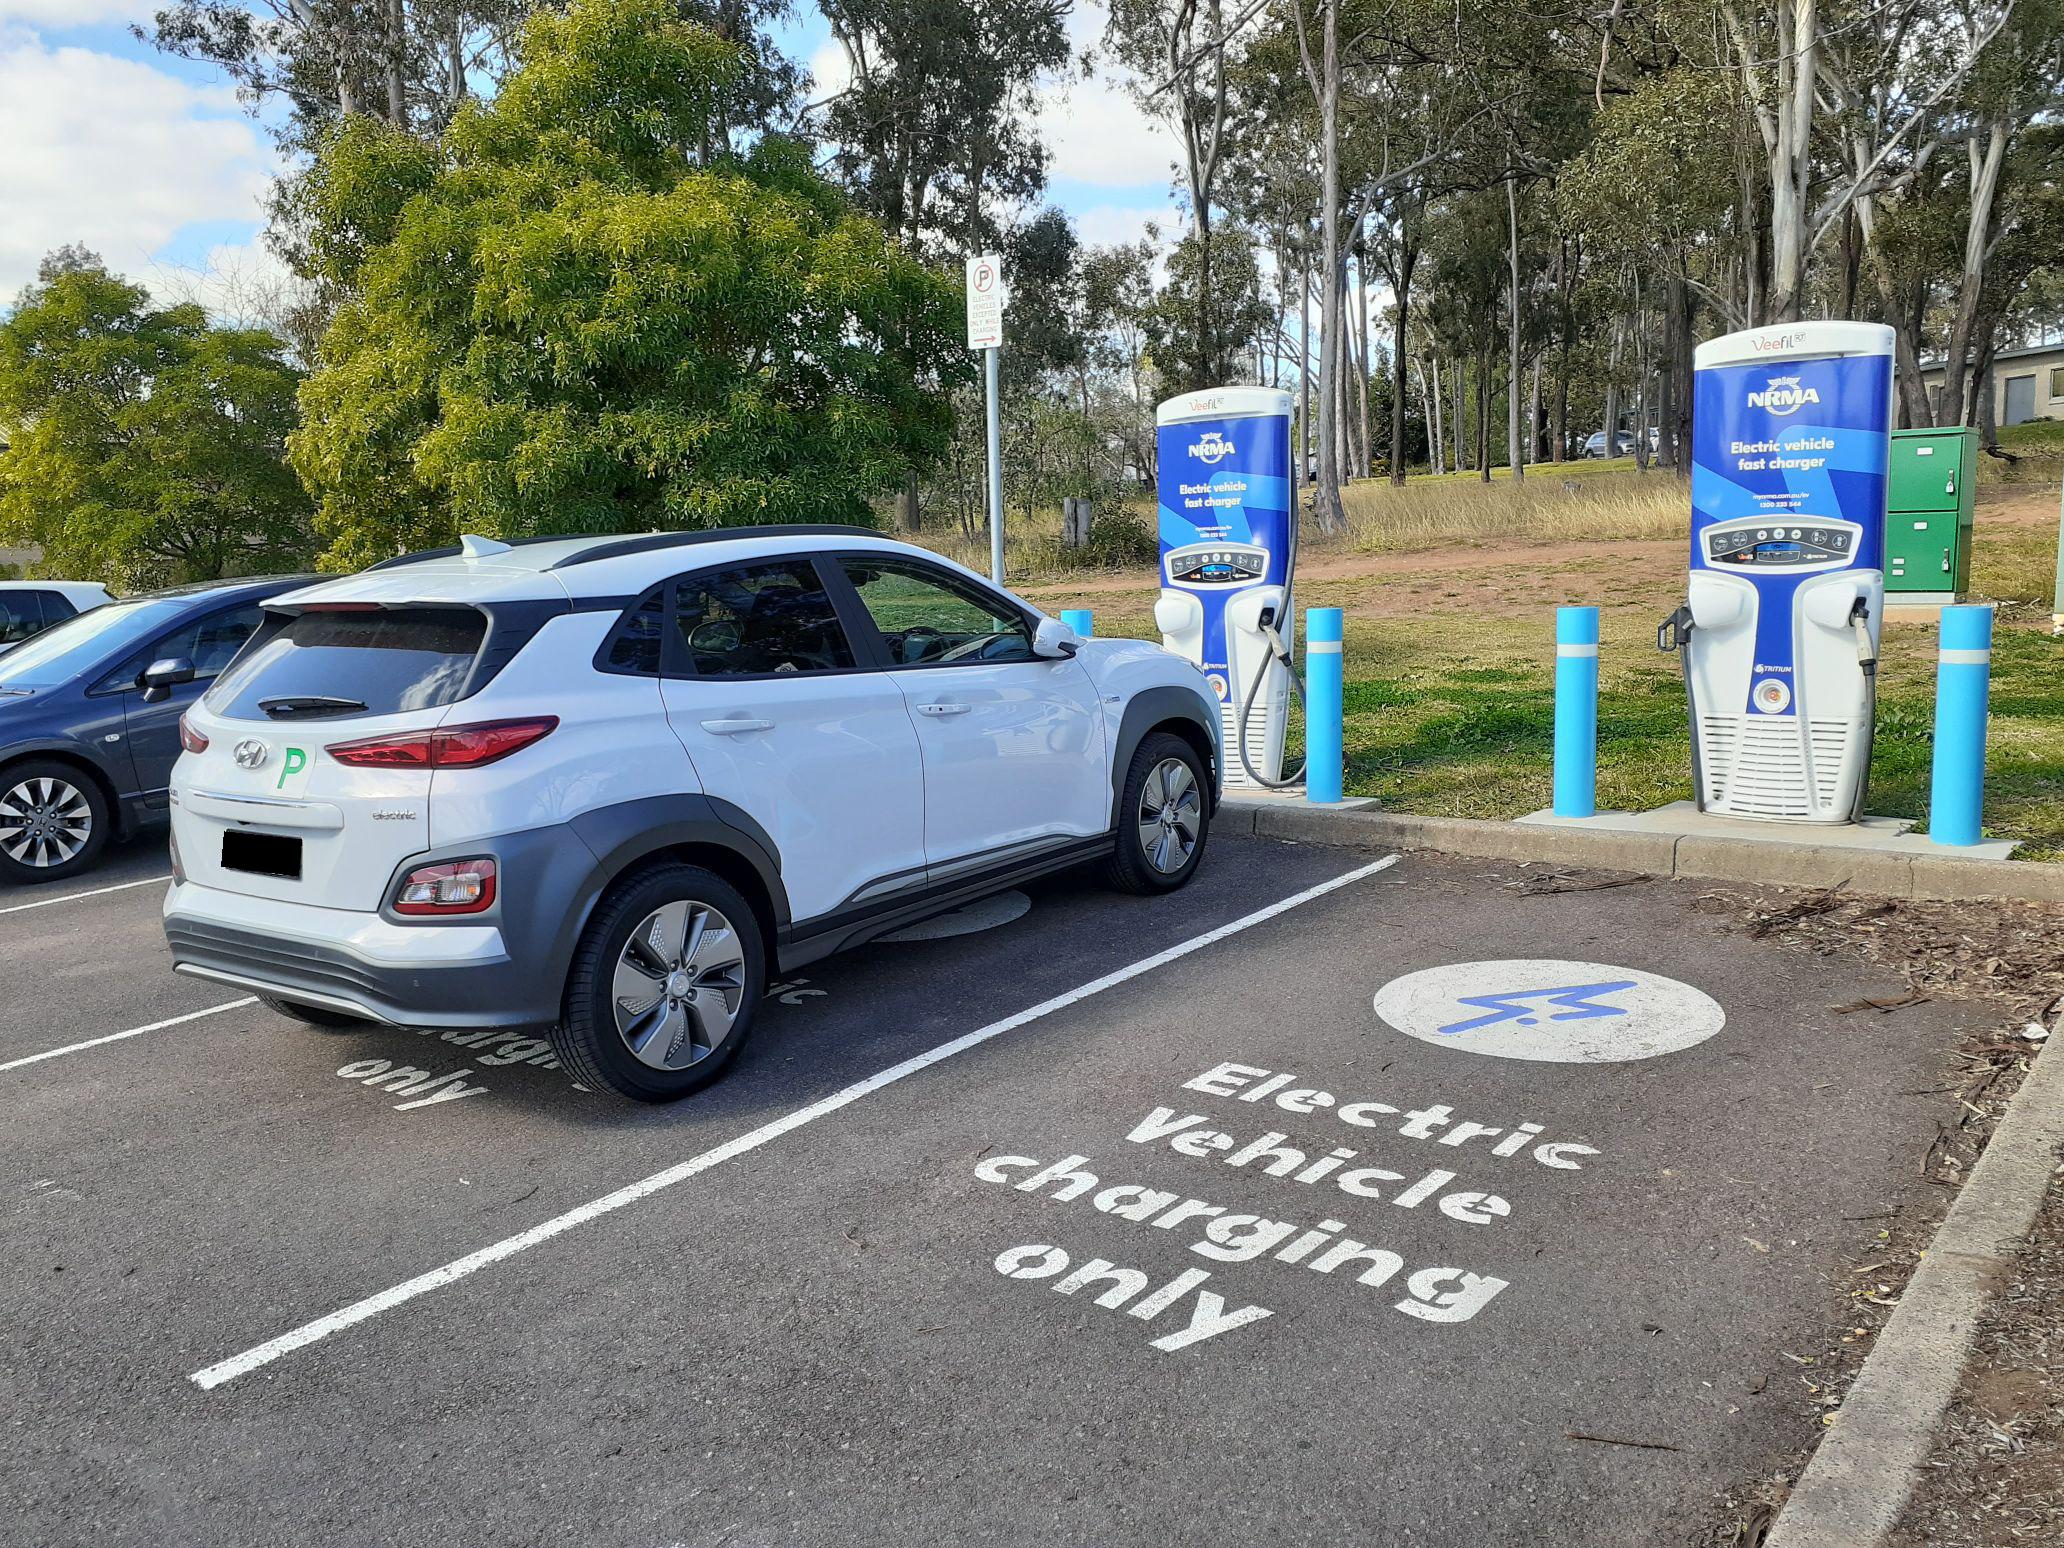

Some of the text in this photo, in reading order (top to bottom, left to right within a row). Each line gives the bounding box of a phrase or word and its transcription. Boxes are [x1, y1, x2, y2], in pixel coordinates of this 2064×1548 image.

[1751, 335, 1794, 351] Veefil
[1189, 399, 1217, 411] Veefil
[1747, 388, 1820, 408] NRMA
[1188, 441, 1236, 457] NRMA
[1730, 437, 1835, 454] Electric vehicle
[1738, 457, 1825, 471] fast charger
[1179, 480, 1247, 495] Electric vehicle
[1184, 496, 1242, 509] fast charger
[1764, 665, 1792, 673] TRITIUM
[277, 747, 306, 789] P
[372, 809, 416, 820] electric
[336, 1058, 490, 1111] only
[1182, 1062, 1601, 1170] Electric
[1126, 1107, 1511, 1225] Vehicle
[974, 1154, 1510, 1323] charging
[994, 1244, 1276, 1353] only
